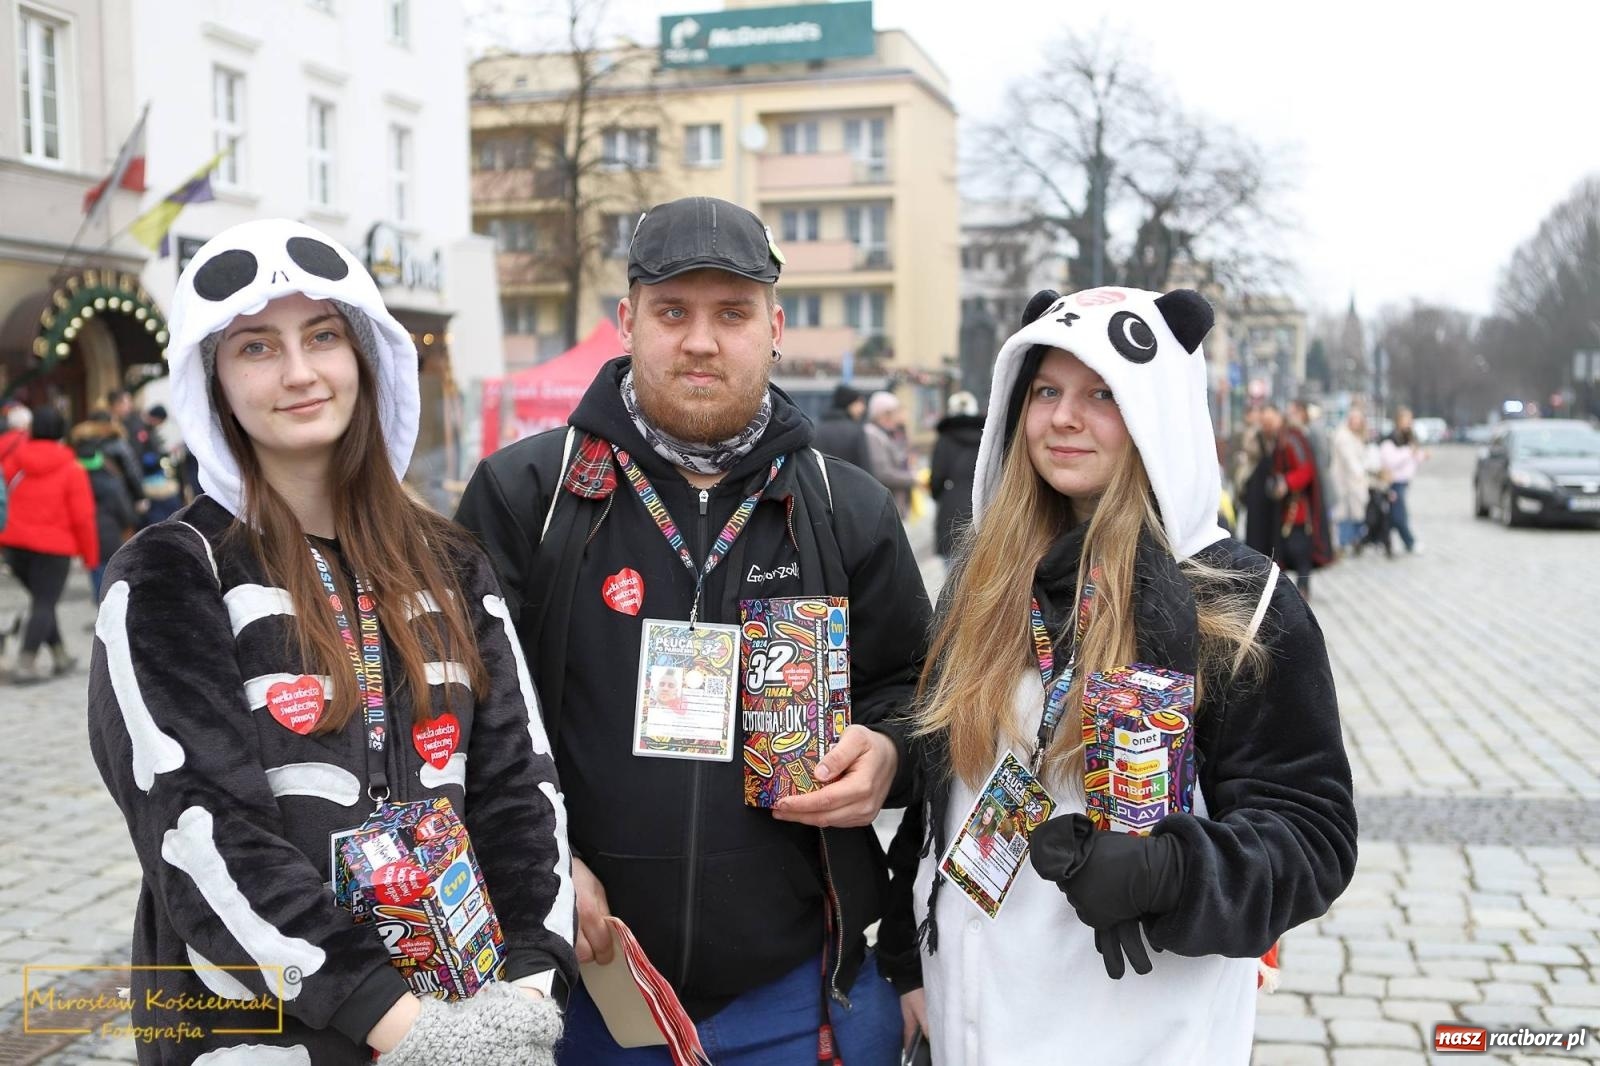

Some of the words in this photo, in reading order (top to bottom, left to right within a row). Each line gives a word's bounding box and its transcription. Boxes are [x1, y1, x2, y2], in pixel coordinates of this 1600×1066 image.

[634, 476, 652, 497] GRA
[643, 493, 677, 539] WSZYSTKO
[720, 502, 753, 542] WSZYSTKO
[669, 534, 683, 551] TU
[714, 539, 728, 554] TU
[831, 622, 843, 633] tvn
[363, 633, 380, 653] GRA
[748, 646, 794, 689] 32
[364, 655, 384, 708] WSZYSTKO
[369, 710, 384, 724] TU
[785, 705, 807, 732] OK!
[1132, 734, 1157, 746] onet
[1001, 767, 1026, 797] PŁUCA
[1118, 783, 1160, 796] mBank
[1025, 800, 1043, 816] 32
[1117, 806, 1161, 822] PLAY
[443, 870, 468, 897] tvn
[378, 922, 409, 957] 2
[415, 970, 445, 995] OK!
